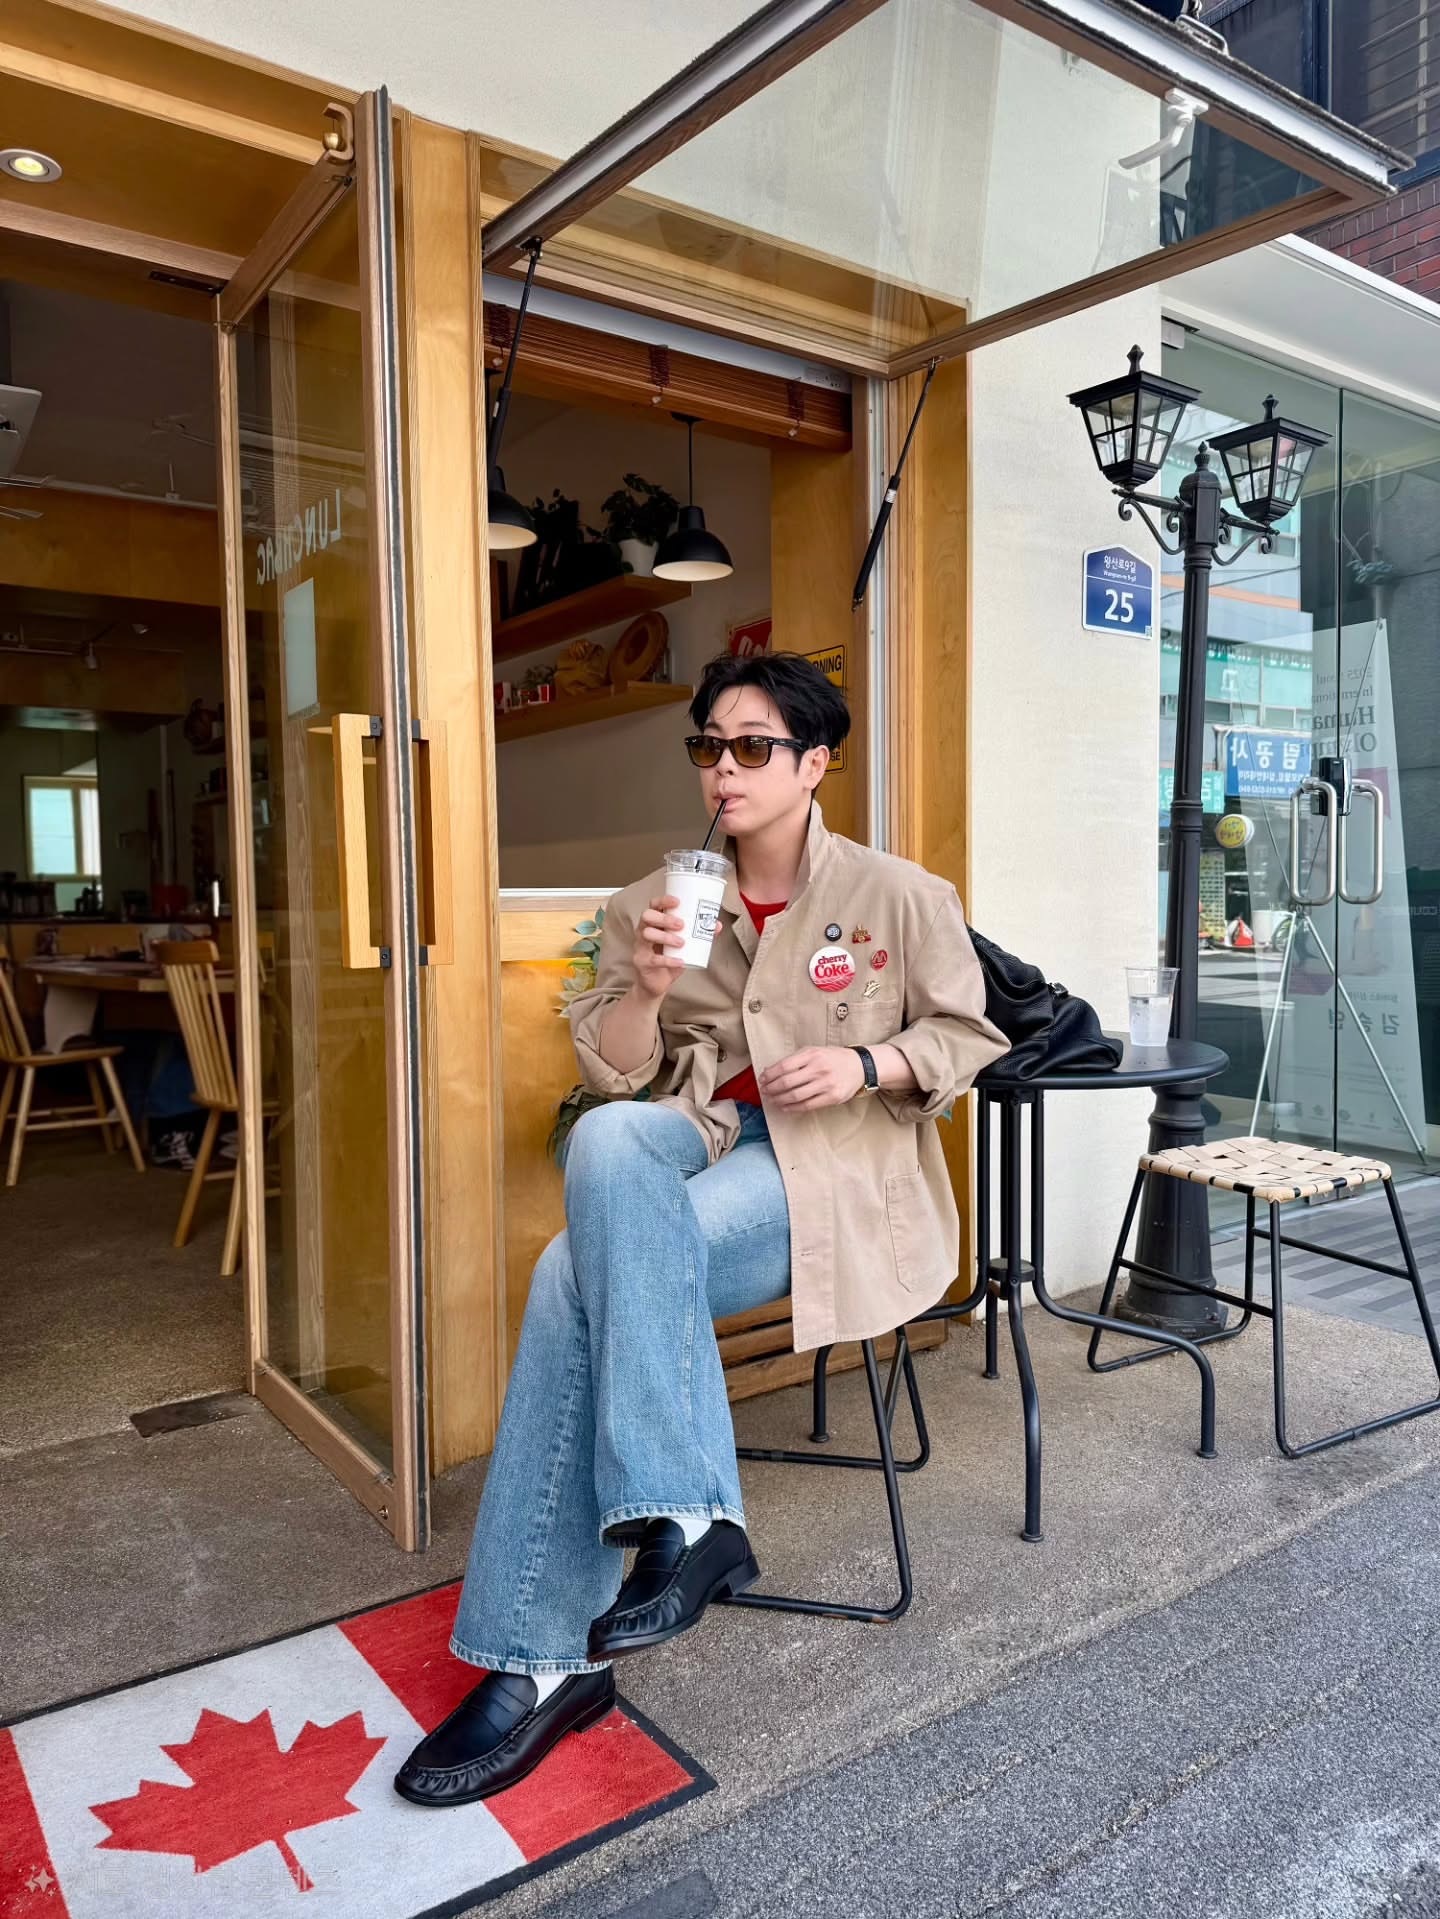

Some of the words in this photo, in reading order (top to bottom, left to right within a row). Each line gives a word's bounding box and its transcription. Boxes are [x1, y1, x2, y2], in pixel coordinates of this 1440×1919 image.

[1104, 588, 1134, 623] 25
[817, 953, 848, 965] cherry
[814, 964, 849, 978] Coke
